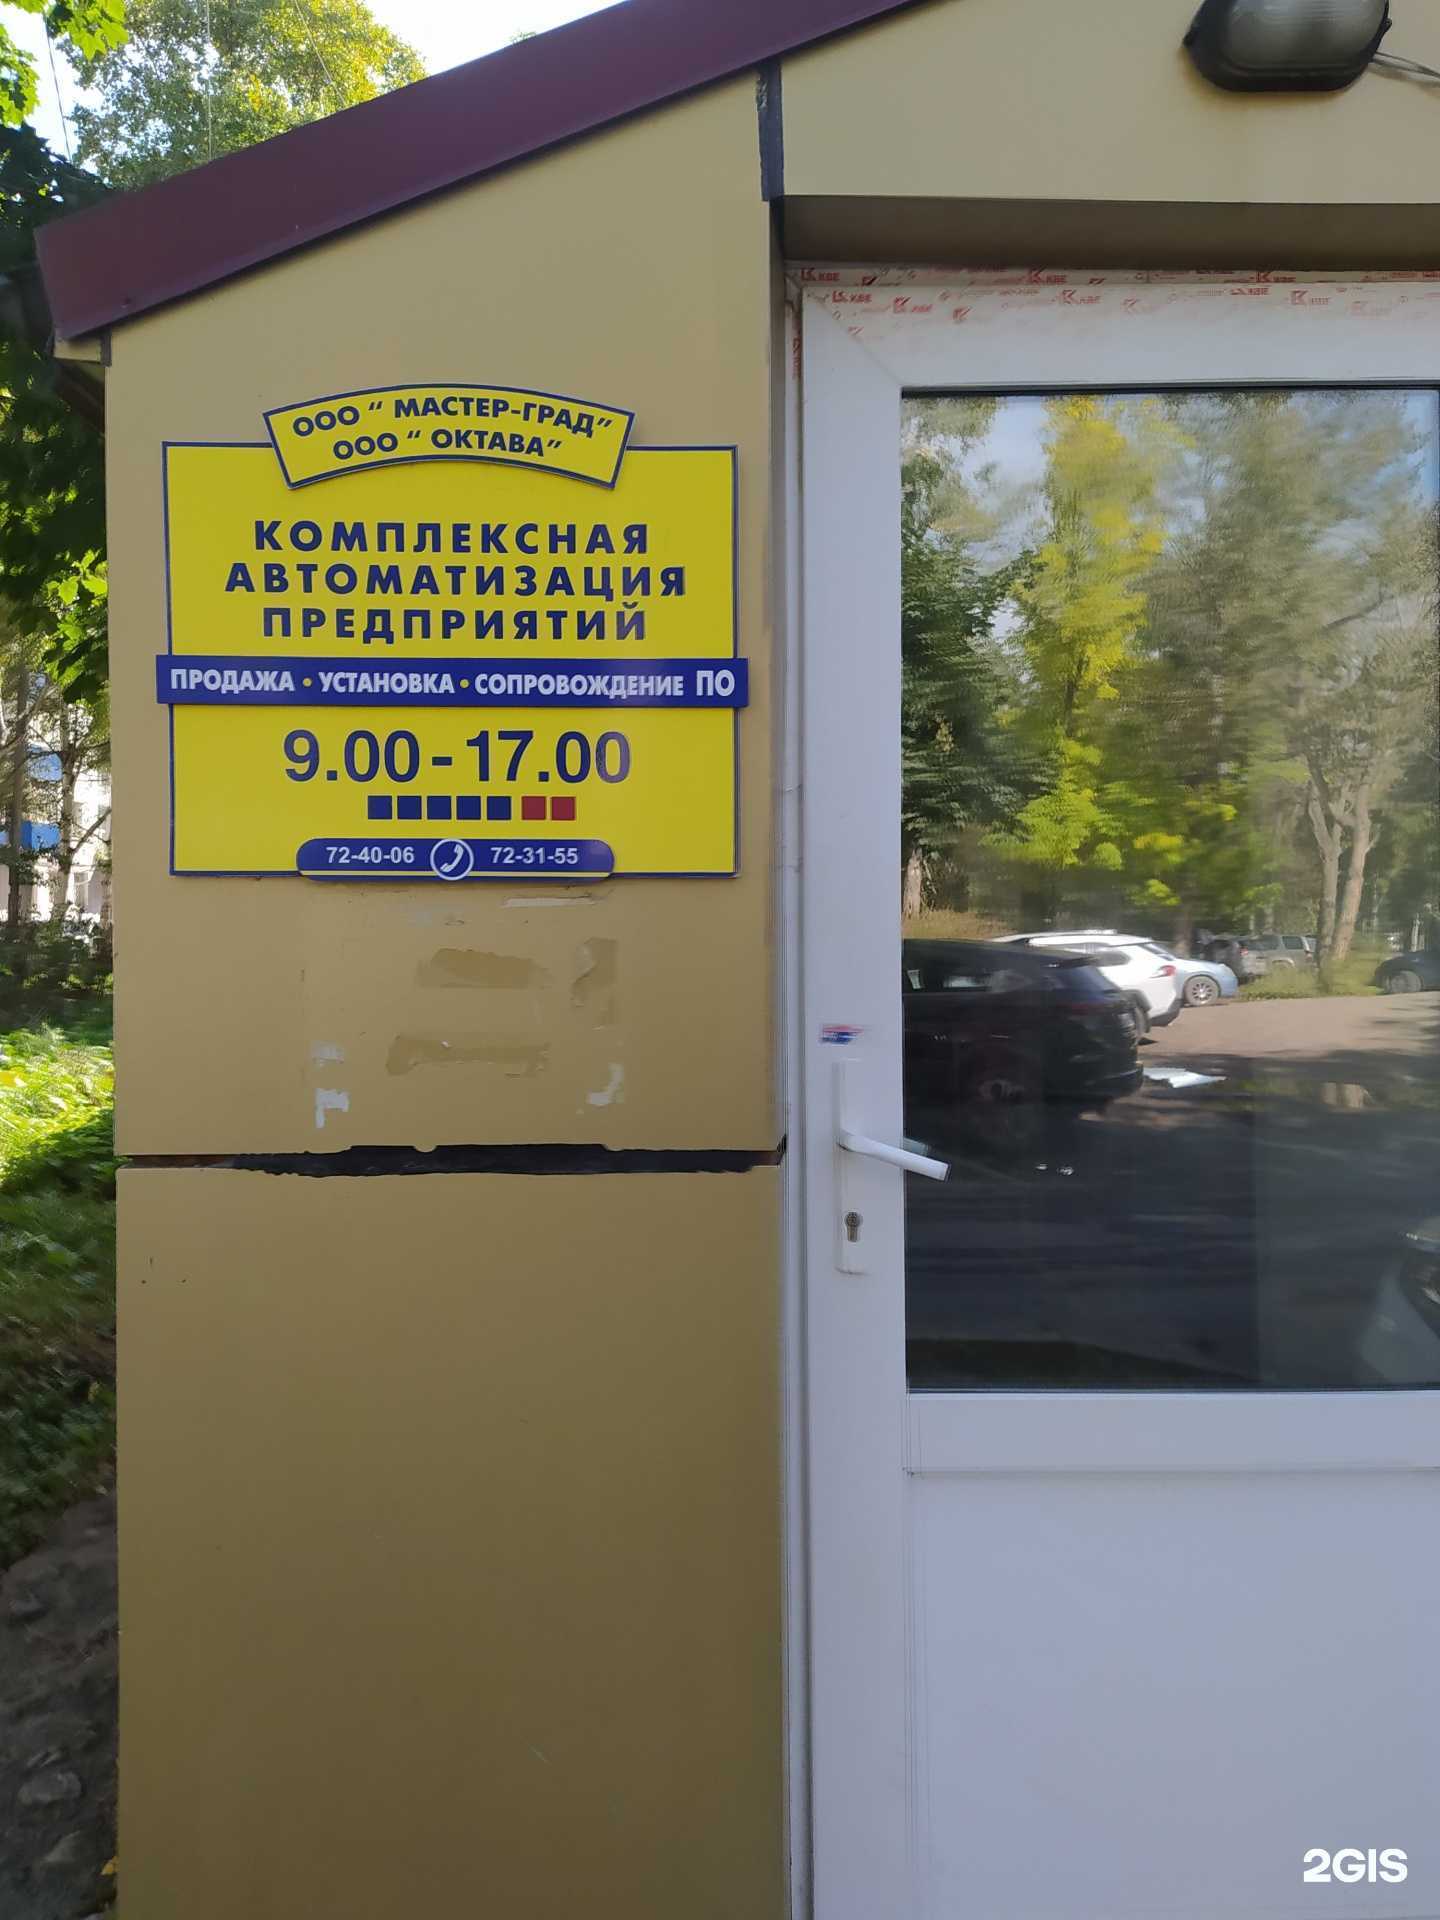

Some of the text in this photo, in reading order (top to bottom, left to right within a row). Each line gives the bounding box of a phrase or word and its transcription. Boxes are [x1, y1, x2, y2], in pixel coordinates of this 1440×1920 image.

[293, 404, 361, 437] ООО
[332, 432, 399, 460] ООО
[254, 519, 648, 555] КОМПЛЕКСНАЯ
[225, 562, 686, 602] АВТОМАТИЗАЦИЯ
[262, 601, 646, 645] ПРЕДПРИЯТИЙ
[170, 668, 736, 698] ПРОДАЖА УСТАНОВКА СОПРОВОЖДЕНИЕ ПО
[326, 846, 415, 864] 72-40-06
[490, 847, 579, 864] 72-31-55
